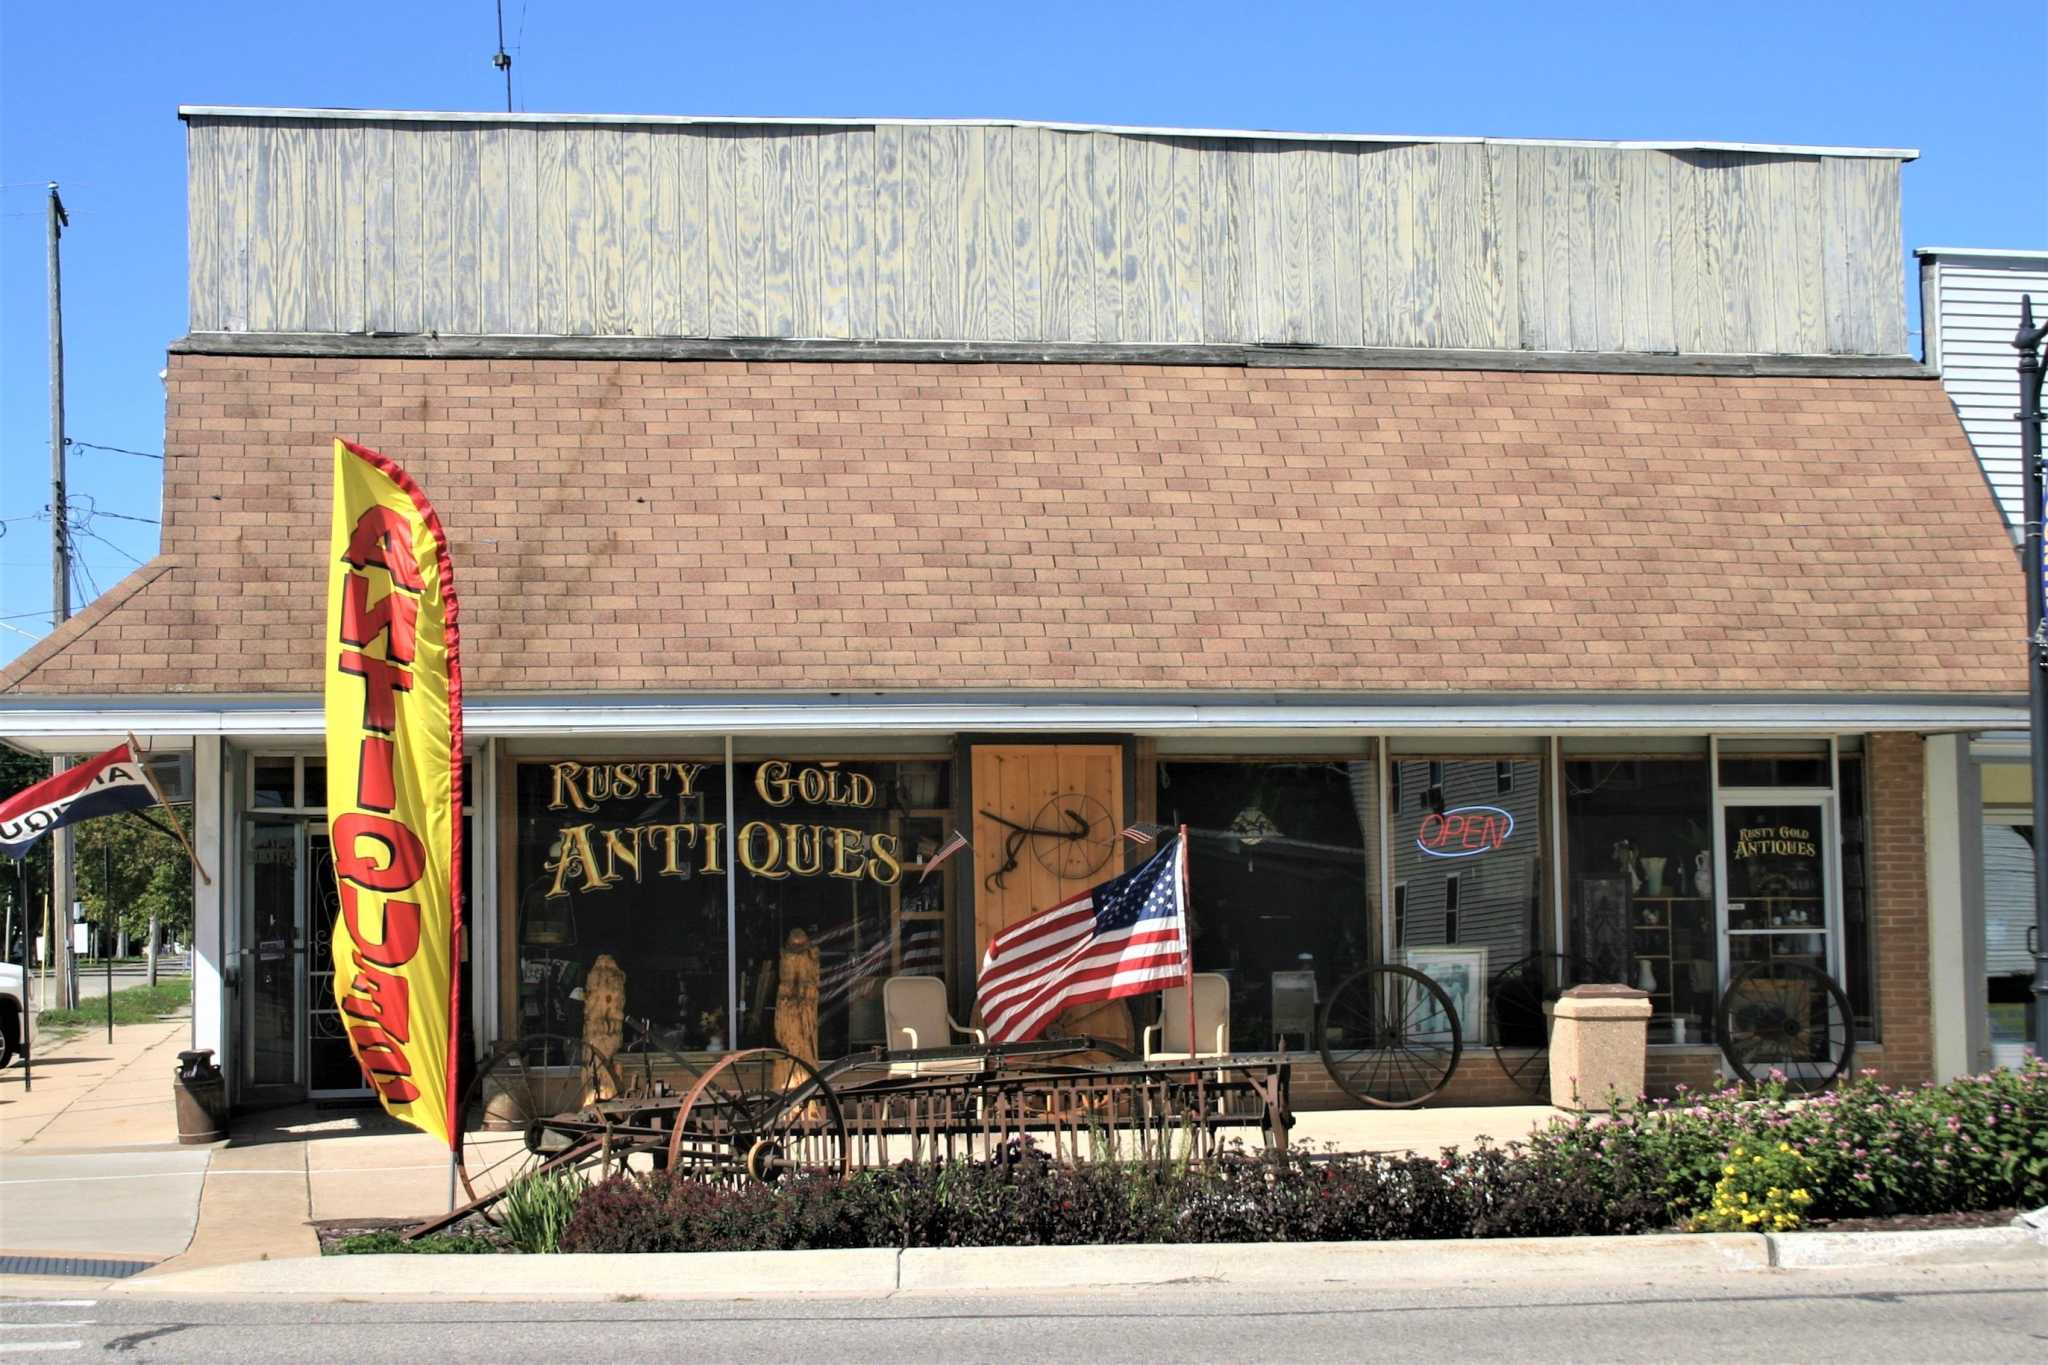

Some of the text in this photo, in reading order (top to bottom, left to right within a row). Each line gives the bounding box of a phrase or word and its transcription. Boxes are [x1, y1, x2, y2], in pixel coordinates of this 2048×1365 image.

[333, 503, 426, 1104] ANTIQUES
[547, 760, 876, 813] RUSTY GOLD
[1420, 813, 1508, 849] OPEN
[1734, 839, 1817, 860] ANTIQUES
[1739, 825, 1809, 842] RUSTY GOLD
[544, 820, 903, 900] ANTIQUES
